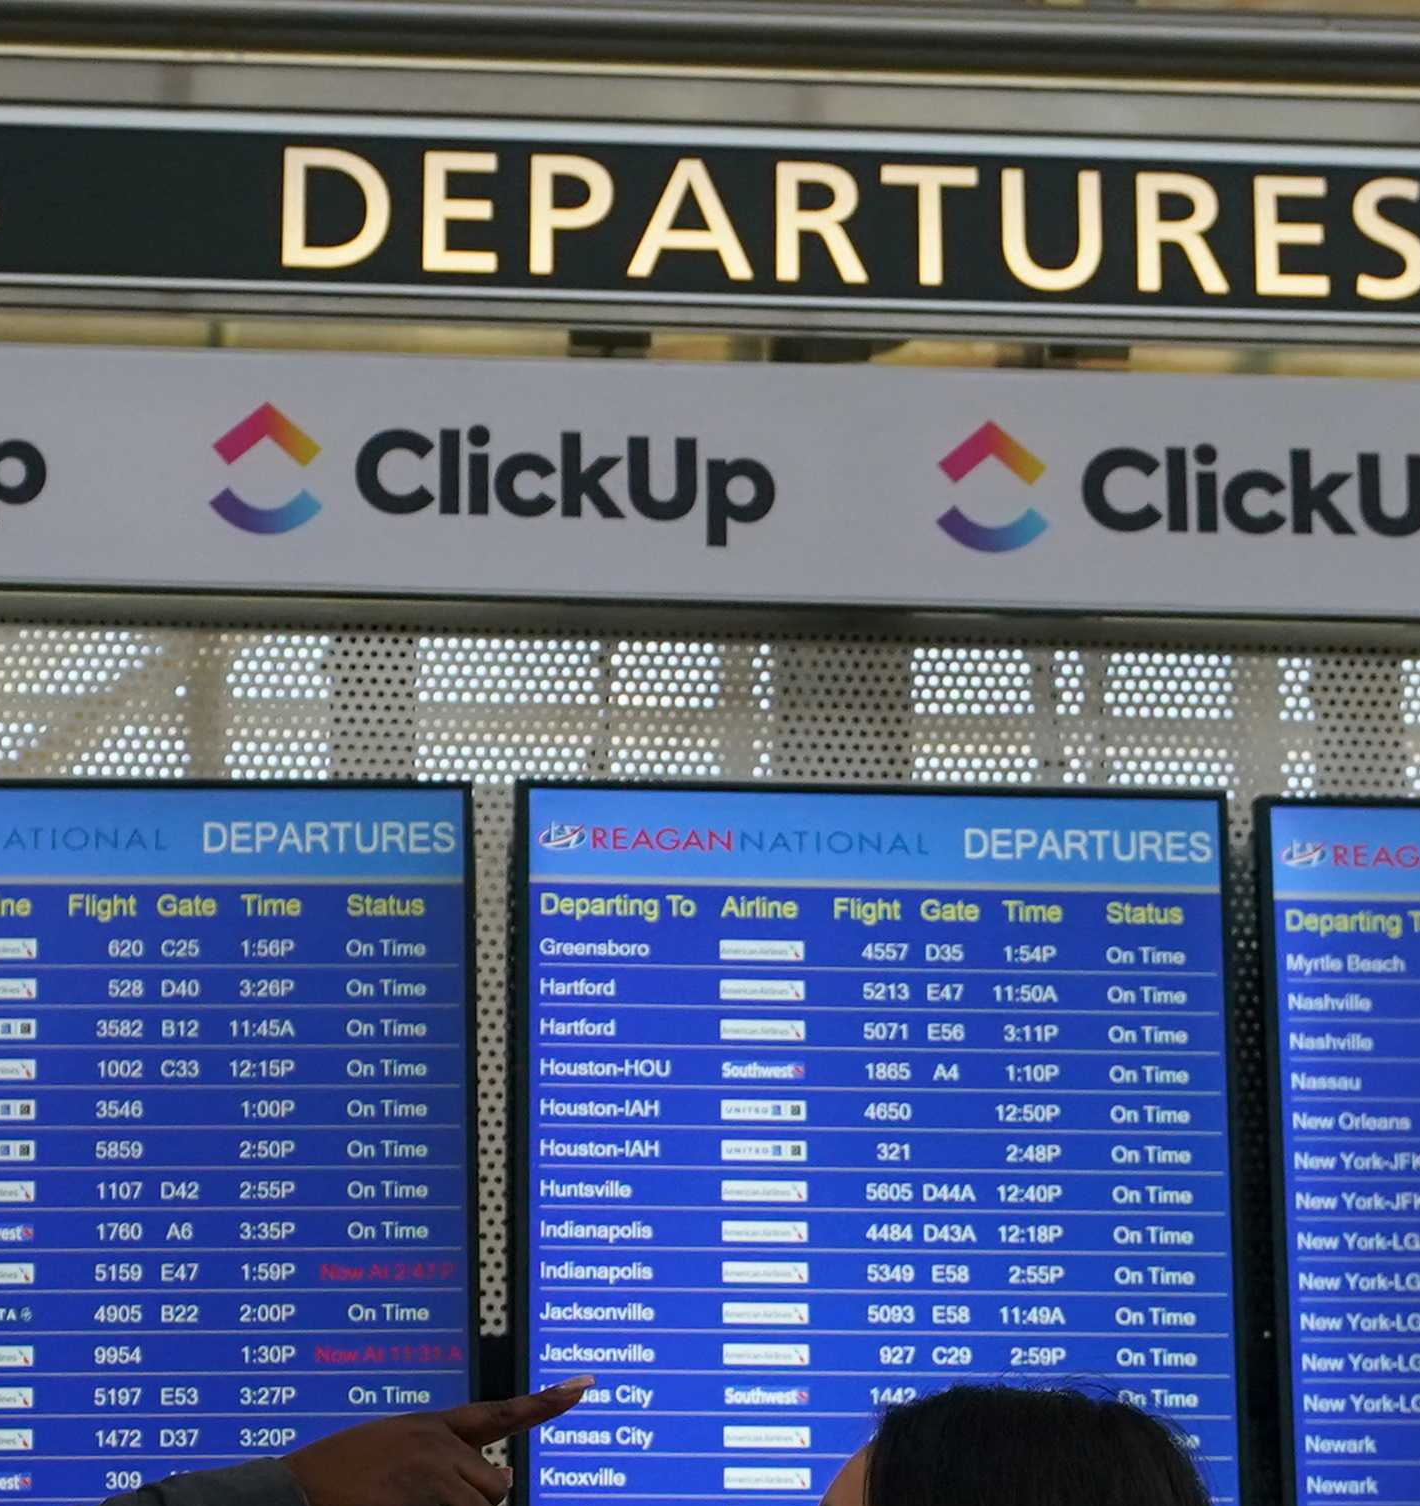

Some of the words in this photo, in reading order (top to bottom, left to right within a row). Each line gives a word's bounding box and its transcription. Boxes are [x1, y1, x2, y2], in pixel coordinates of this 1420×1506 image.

[355, 425, 775, 547] ClickUp
[203, 822, 455, 853] DEPARTURES
[591, 827, 733, 851] REAGAN
[739, 829, 928, 855] NATIONAL
[964, 828, 1212, 863] DEPARTURES
[69, 894, 136, 922] Flight
[157, 894, 217, 917] Gate
[241, 894, 301, 916] Time
[347, 894, 425, 916] Status
[541, 893, 659, 922] Departing
[666, 895, 696, 917] To
[721, 896, 798, 918] Airline
[834, 898, 901, 925] Flight
[920, 899, 980, 922] Gate
[1002, 900, 1062, 923] Time
[1107, 902, 1184, 924] Status
[1285, 909, 1402, 938] Departing
[108, 940, 143, 957] 620
[161, 939, 199, 957] C25
[242, 939, 294, 957] 1:56P
[346, 939, 374, 957] On
[379, 939, 426, 956] Time
[1289, 1032, 1373, 1051] Nashville
[540, 1059, 671, 1077] Houston-HOU
[722, 1062, 797, 1078] Southwest
[866, 1063, 911, 1080] 1865
[933, 1064, 959, 1080] A4
[1006, 1064, 1059, 1082] 1:10P
[1109, 1065, 1138, 1083] On
[1142, 1066, 1189, 1084] Time
[97, 1223, 142, 1240] 1760
[166, 1223, 193, 1240] A6
[240, 1222, 295, 1240] 3:35P
[348, 1222, 376, 1239] On
[381, 1221, 428, 1238] Time
[94, 1305, 142, 1322] 4905
[161, 1305, 198, 1322] B22
[240, 1304, 295, 1322] 2:00P
[348, 1304, 376, 1321] On
[382, 1304, 429, 1320] Time
[540, 1426, 608, 1444] Kansas
[616, 1426, 653, 1449] City
[1305, 1435, 1376, 1453] Newark
